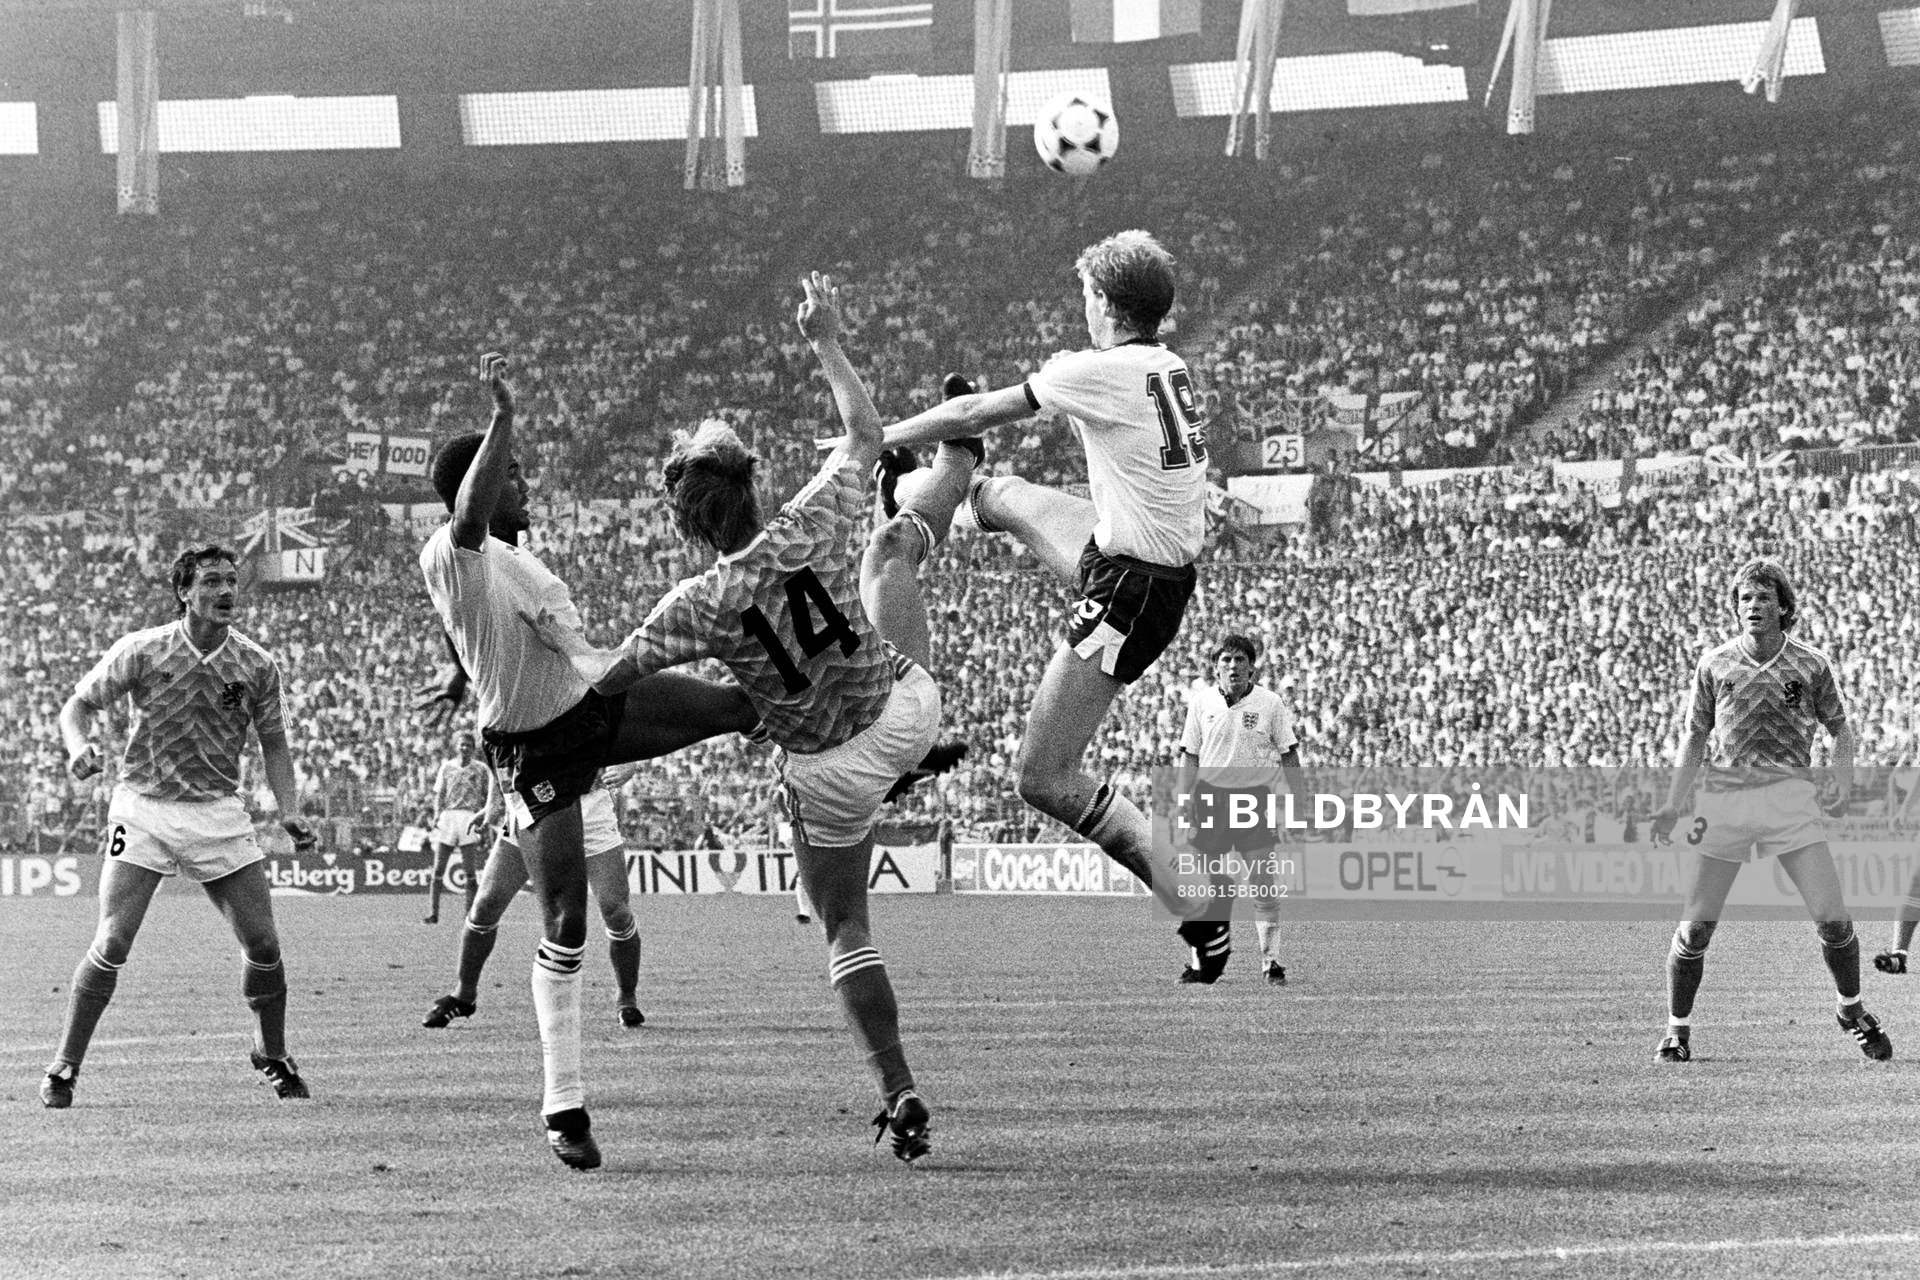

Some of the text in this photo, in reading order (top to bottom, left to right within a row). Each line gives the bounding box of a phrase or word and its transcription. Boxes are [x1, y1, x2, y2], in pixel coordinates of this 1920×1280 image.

[1266, 438, 1299, 465] 25
[741, 565, 861, 695] 14
[110, 825, 126, 857] 6
[1687, 816, 1708, 845] 3
[364, 859, 433, 887] Beer
[984, 848, 1103, 891] Coca-Cola
[1339, 851, 1437, 891] OPEL
[1503, 850, 1700, 894] JVC VIDEO TAP
